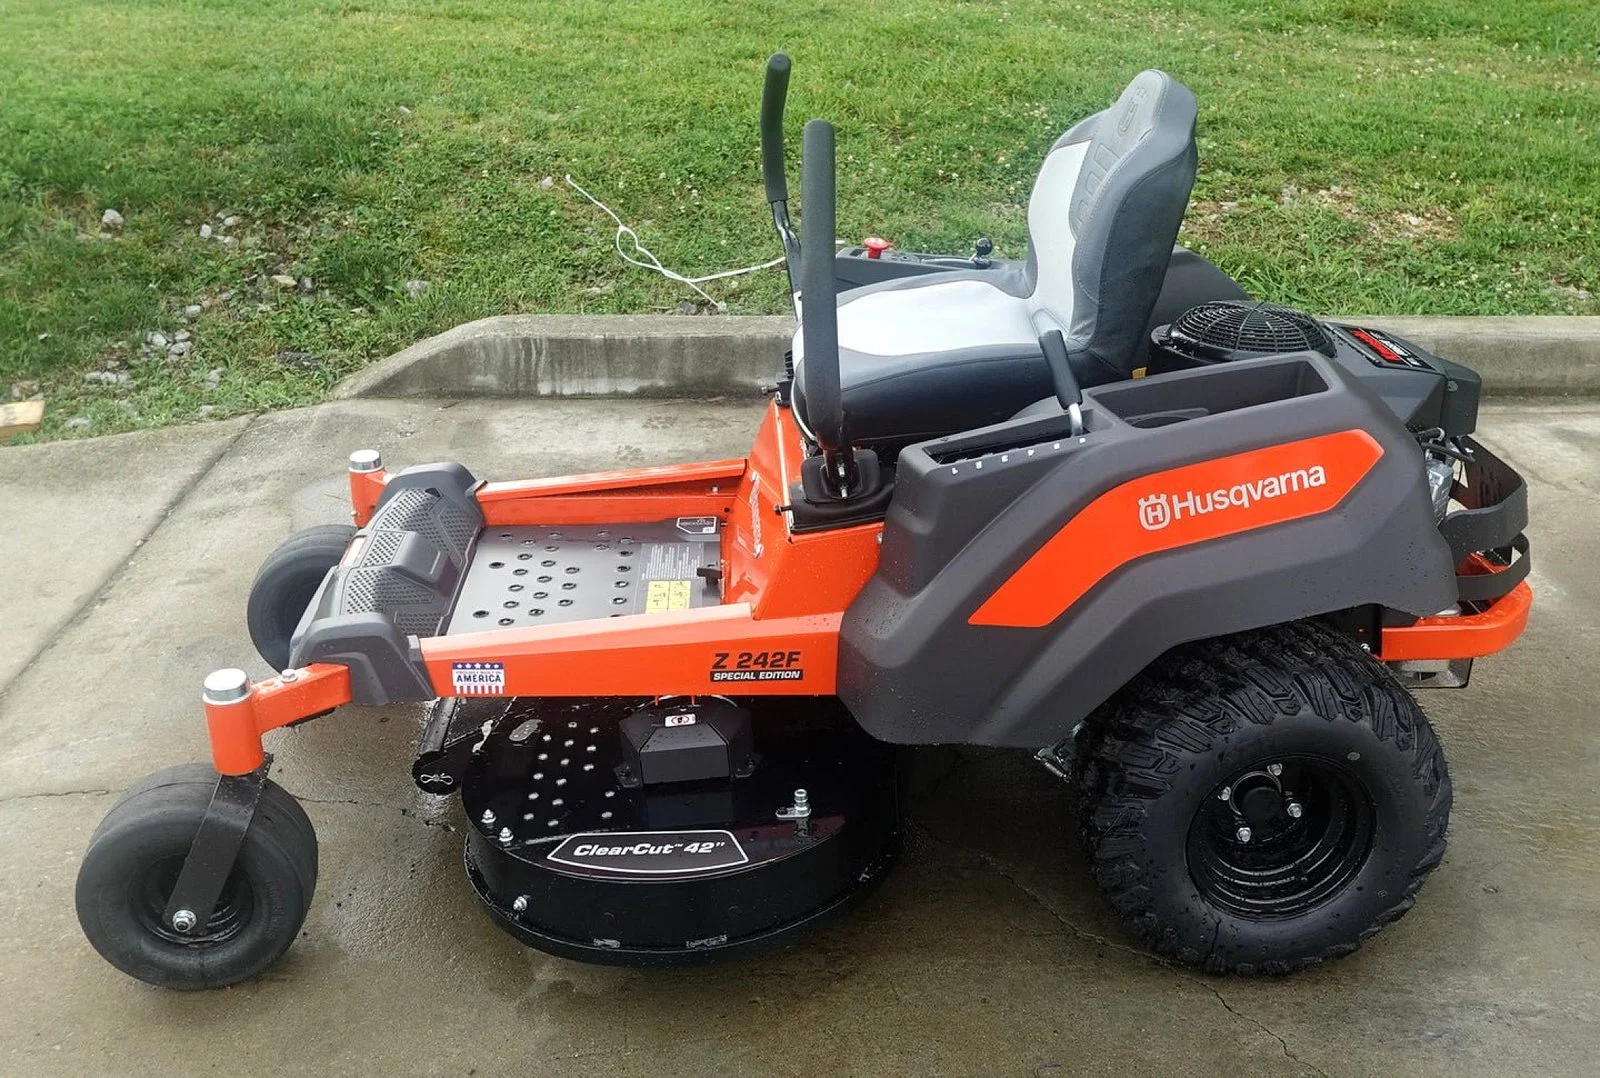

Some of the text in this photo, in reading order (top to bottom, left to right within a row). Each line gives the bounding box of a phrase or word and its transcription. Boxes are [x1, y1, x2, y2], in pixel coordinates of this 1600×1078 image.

[1172, 465, 1326, 520] Husqvarna
[712, 651, 801, 669] Z 242F
[456, 674, 501, 683] AMERICA
[713, 670, 800, 680] SPECIAL EDITION
